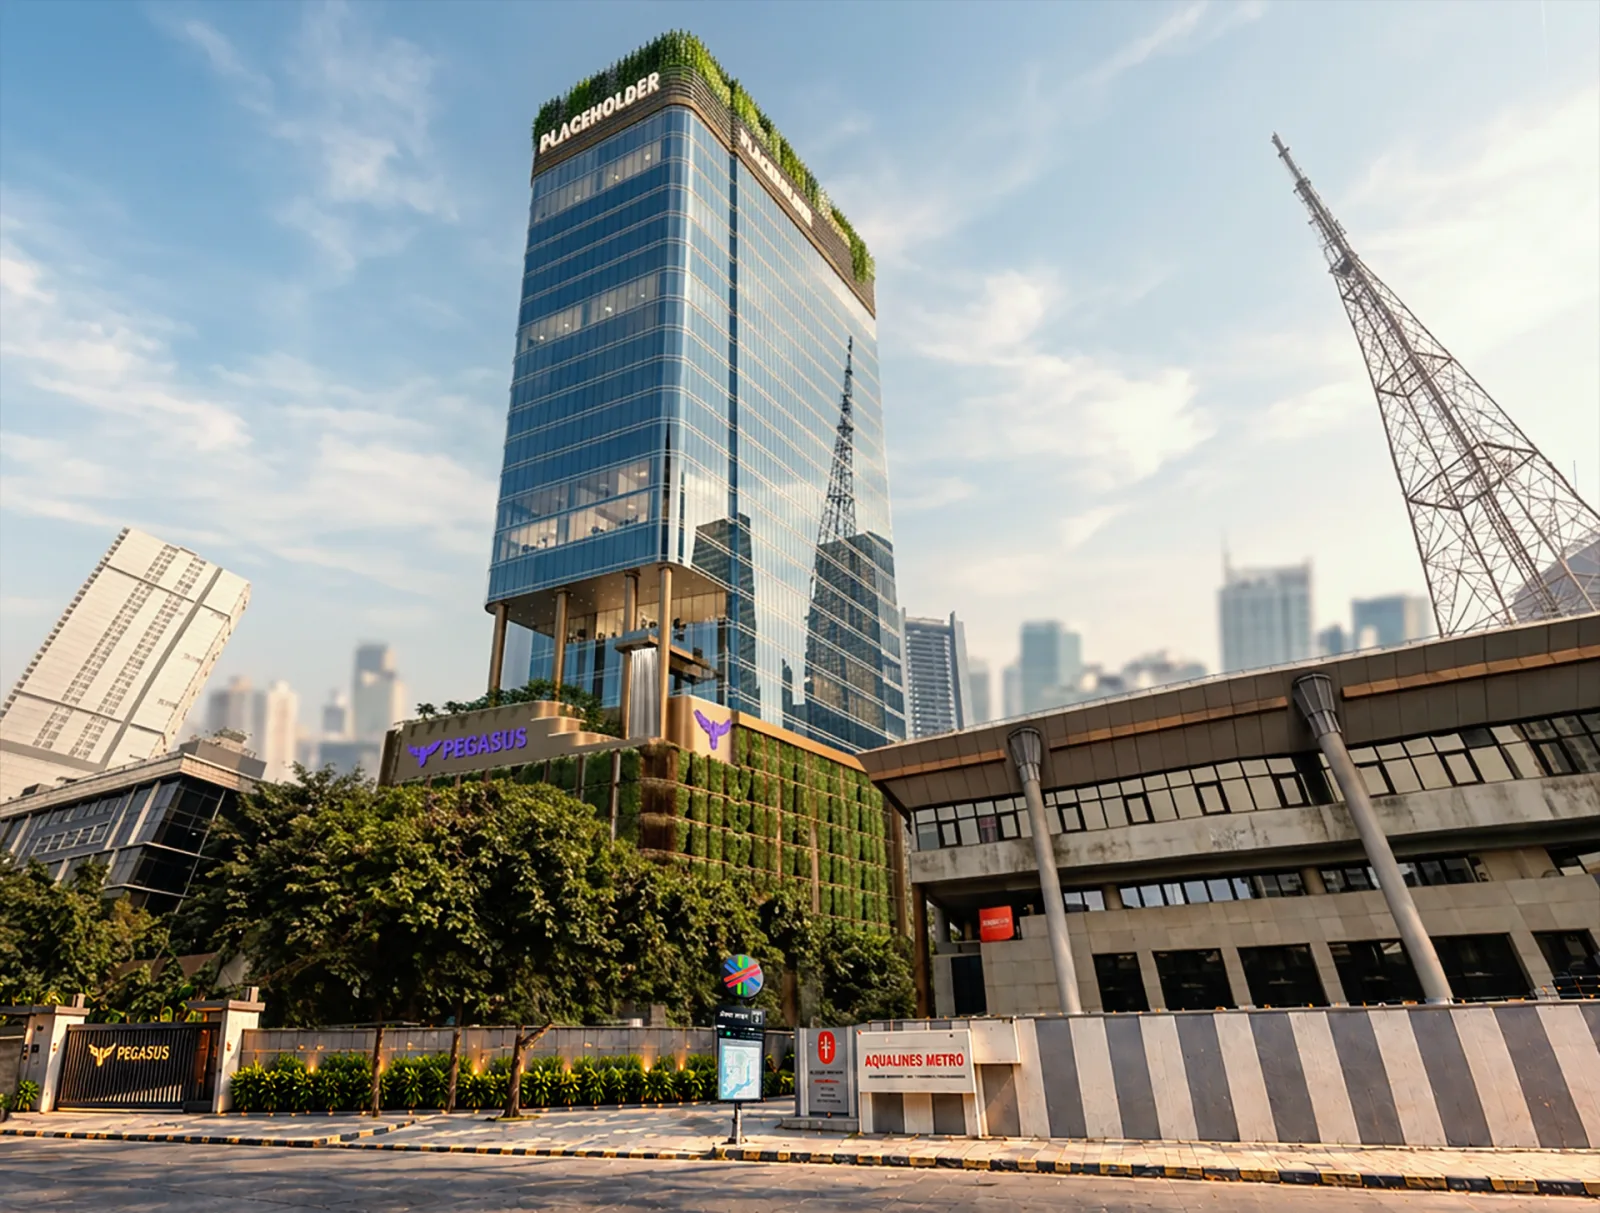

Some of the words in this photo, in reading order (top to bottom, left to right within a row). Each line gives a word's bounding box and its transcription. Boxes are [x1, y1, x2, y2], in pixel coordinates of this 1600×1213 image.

[539, 71, 660, 153] PLACEHOLDER
[442, 727, 527, 760] PEGASUS
[117, 1046, 170, 1060] PEGASUS
[865, 1054, 922, 1069] AQUALINES
[926, 1053, 964, 1066] METRO
